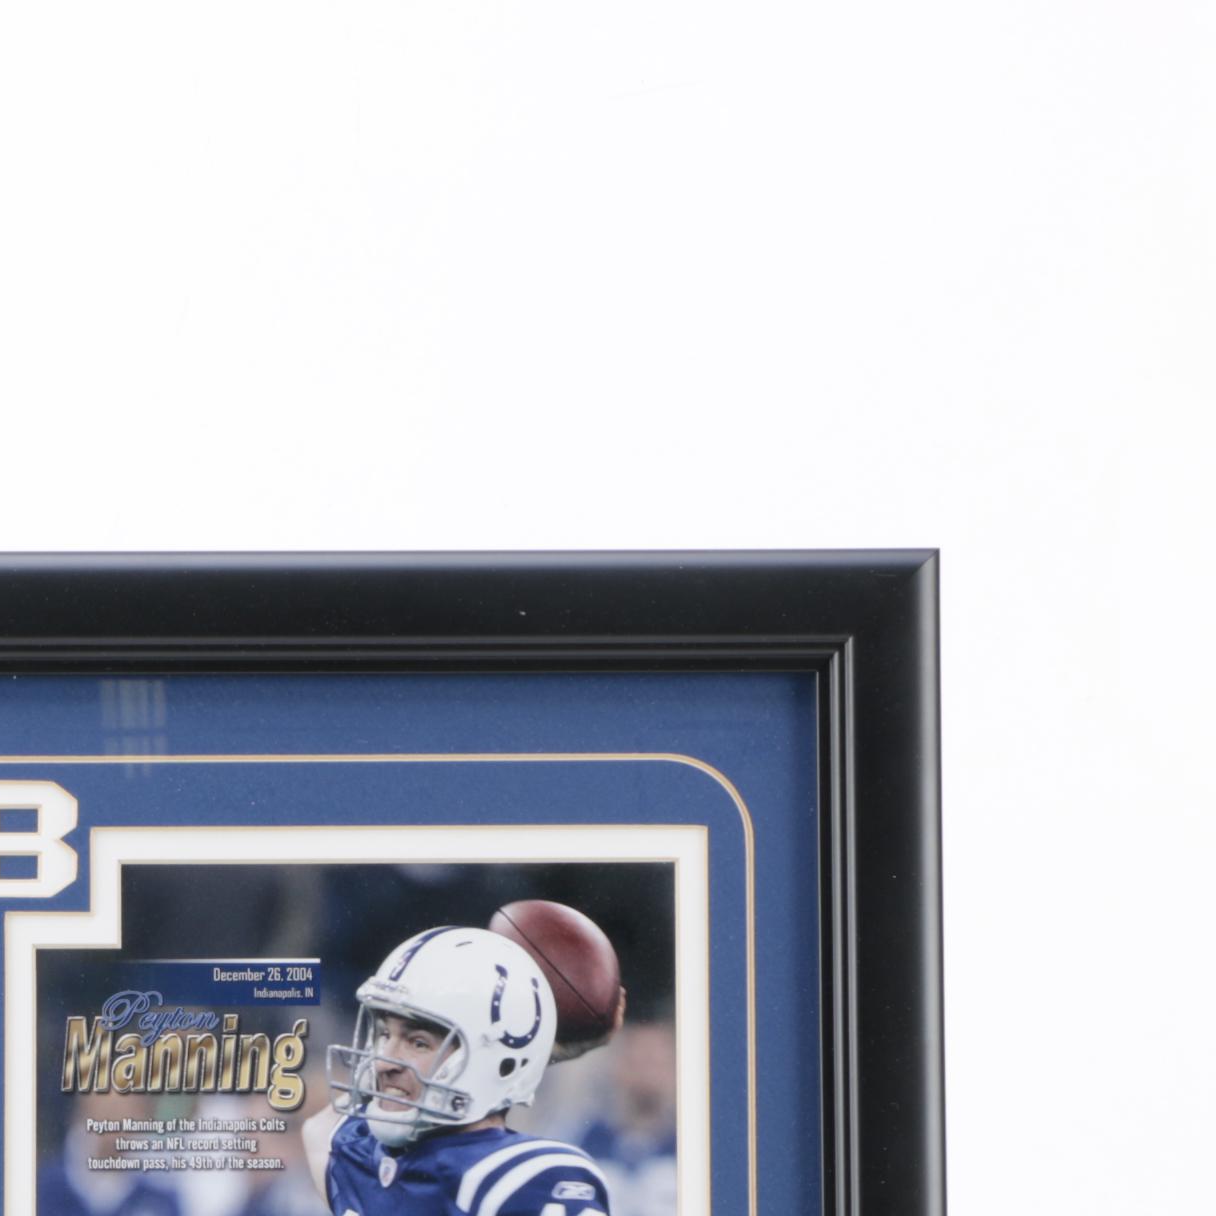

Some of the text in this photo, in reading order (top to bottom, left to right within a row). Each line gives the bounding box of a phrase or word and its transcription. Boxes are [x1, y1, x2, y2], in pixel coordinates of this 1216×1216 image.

[213, 967, 313, 982] December 26, 2004
[305, 987, 314, 998] IN
[99, 990, 220, 1048] Peyton
[60, 1013, 308, 1111] Manning
[86, 1118, 286, 1134] Peyton Manning of the Indianapolis Colts
[115, 1137, 258, 1153] throws an NFL record setting
[87, 1156, 285, 1172] touchdown pass, his 49th of the season.
